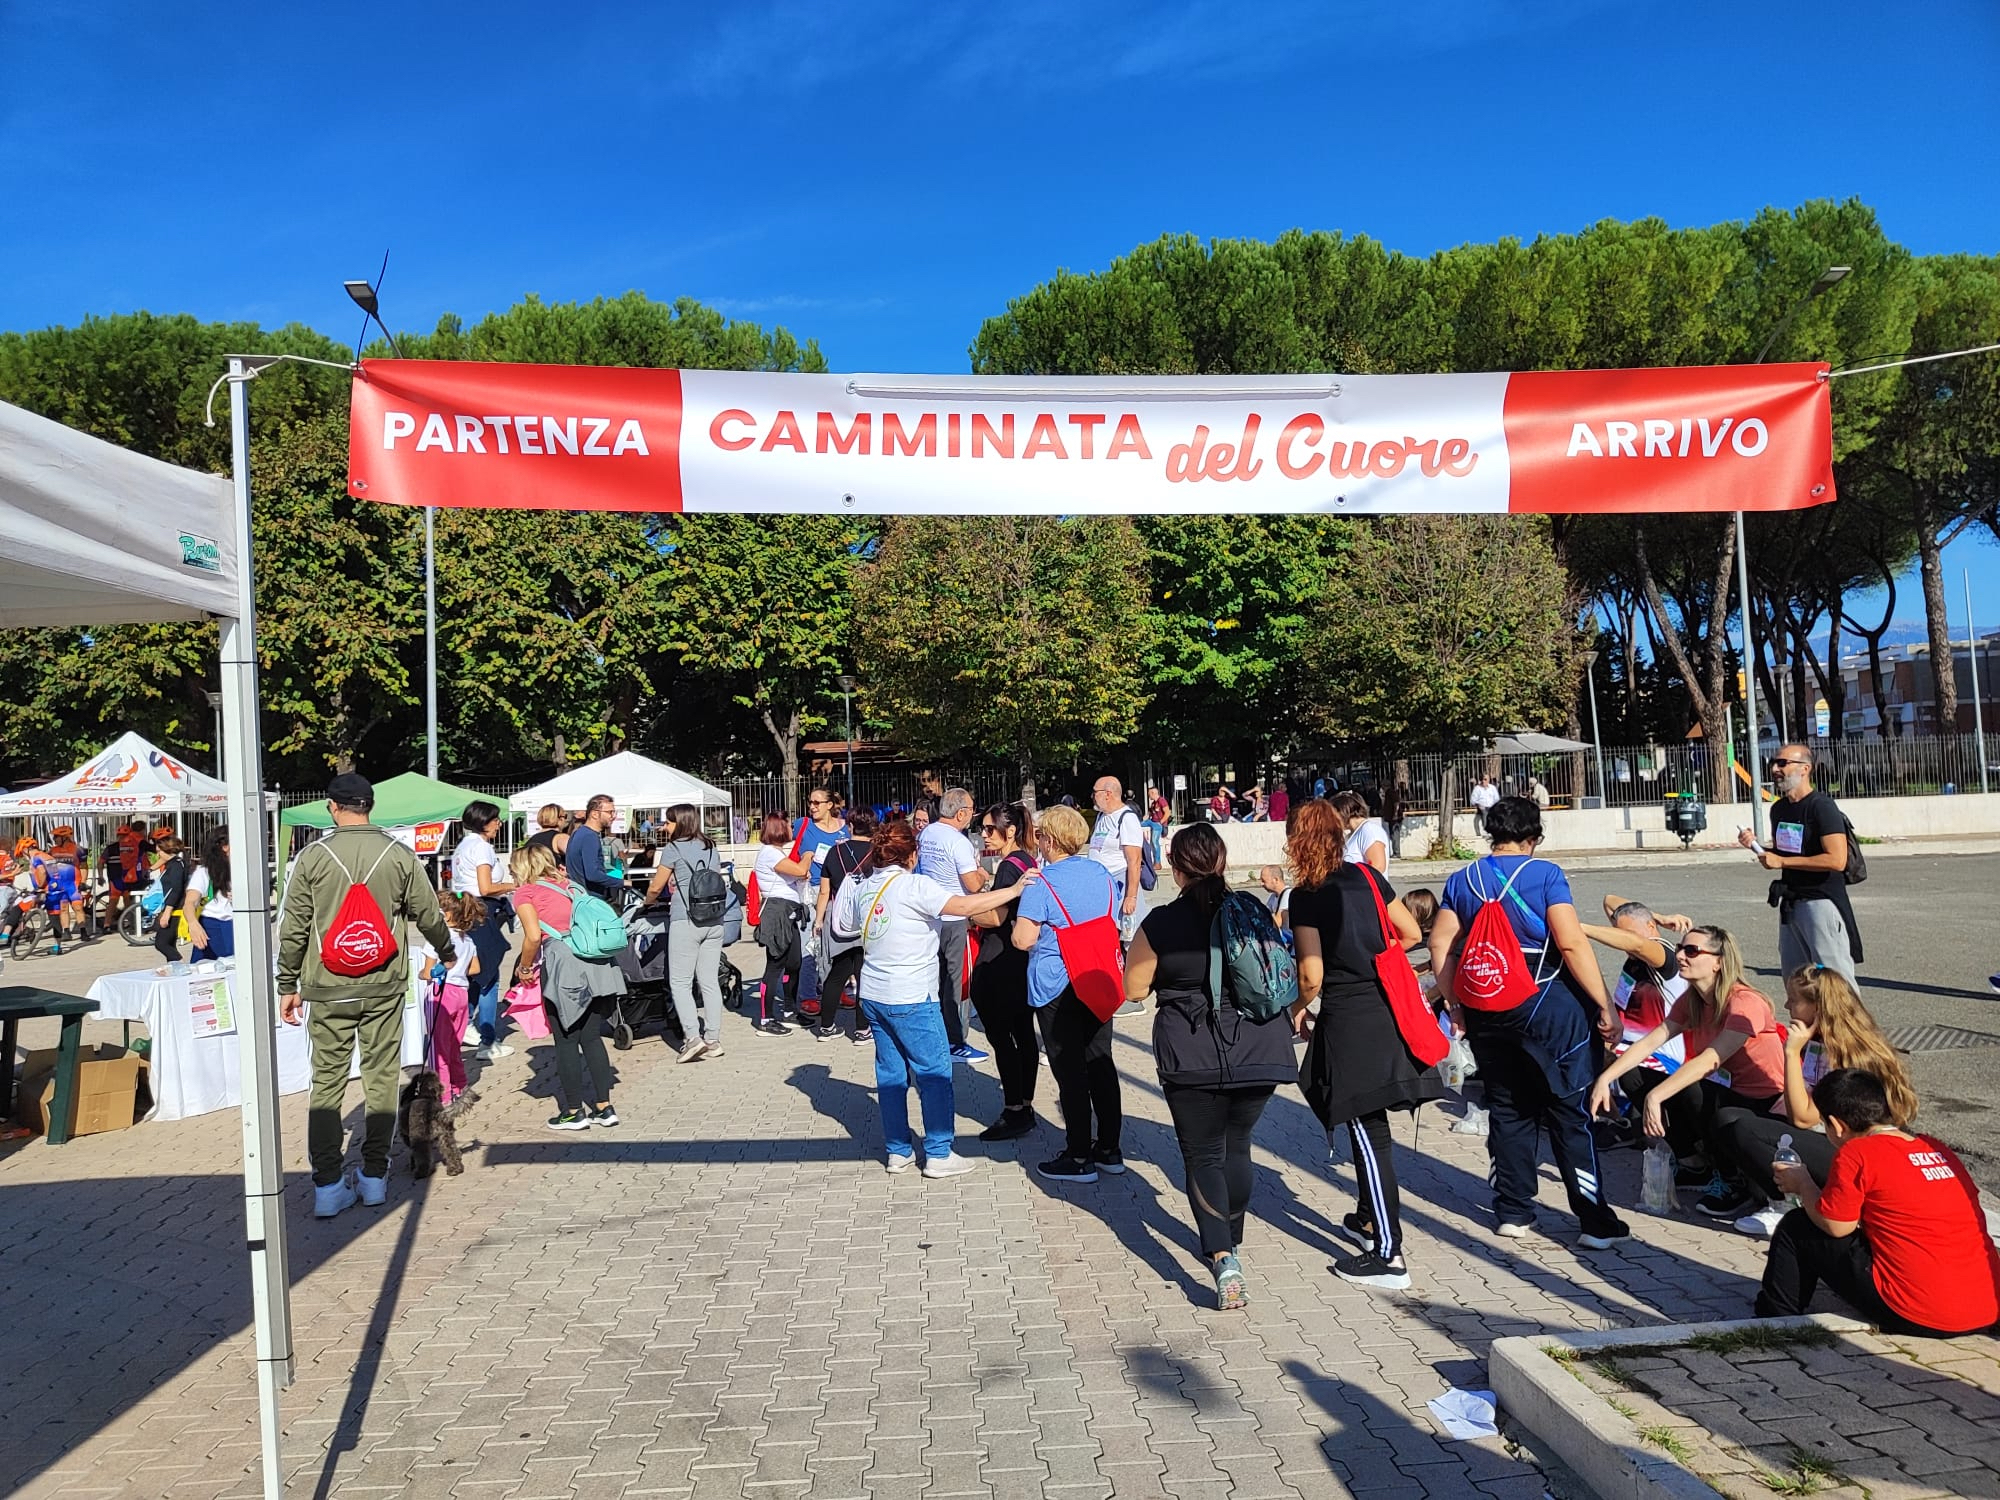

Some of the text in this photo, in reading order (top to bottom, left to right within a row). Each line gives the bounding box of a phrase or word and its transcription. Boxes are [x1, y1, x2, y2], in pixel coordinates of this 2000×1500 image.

[382, 411, 650, 457] PARTENZA
[709, 408, 1477, 483] CAMMINATA del Cuore
[1566, 417, 1770, 459] ARRIVO
[420, 827, 440, 835] END
[1908, 1152, 1948, 1166] SKATE
[1920, 1166, 1956, 1181] BORD
